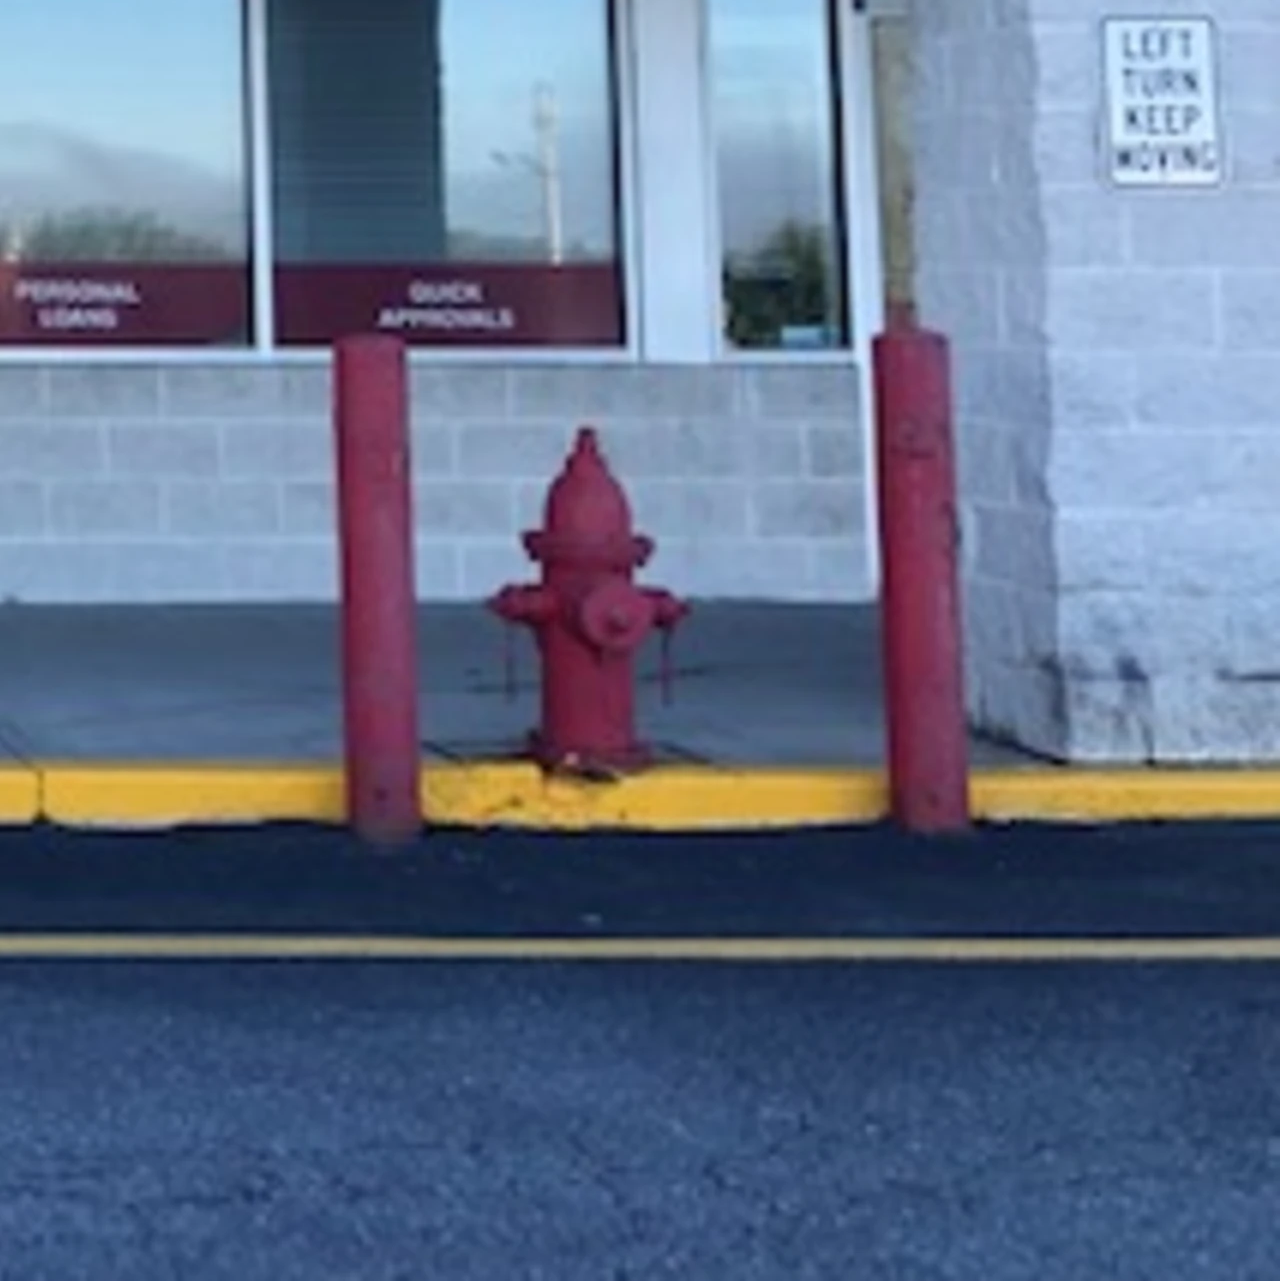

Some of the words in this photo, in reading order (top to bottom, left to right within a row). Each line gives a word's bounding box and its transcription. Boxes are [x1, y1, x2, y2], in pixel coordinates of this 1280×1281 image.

[1122, 29, 1193, 61] LEFT
[1122, 67, 1201, 98] TURN
[1125, 104, 1202, 135] KEEP
[13, 280, 139, 301] PERSONAL
[409, 281, 482, 303] QUICK
[37, 308, 117, 328] LOANS
[378, 307, 514, 329] APPROVALS
